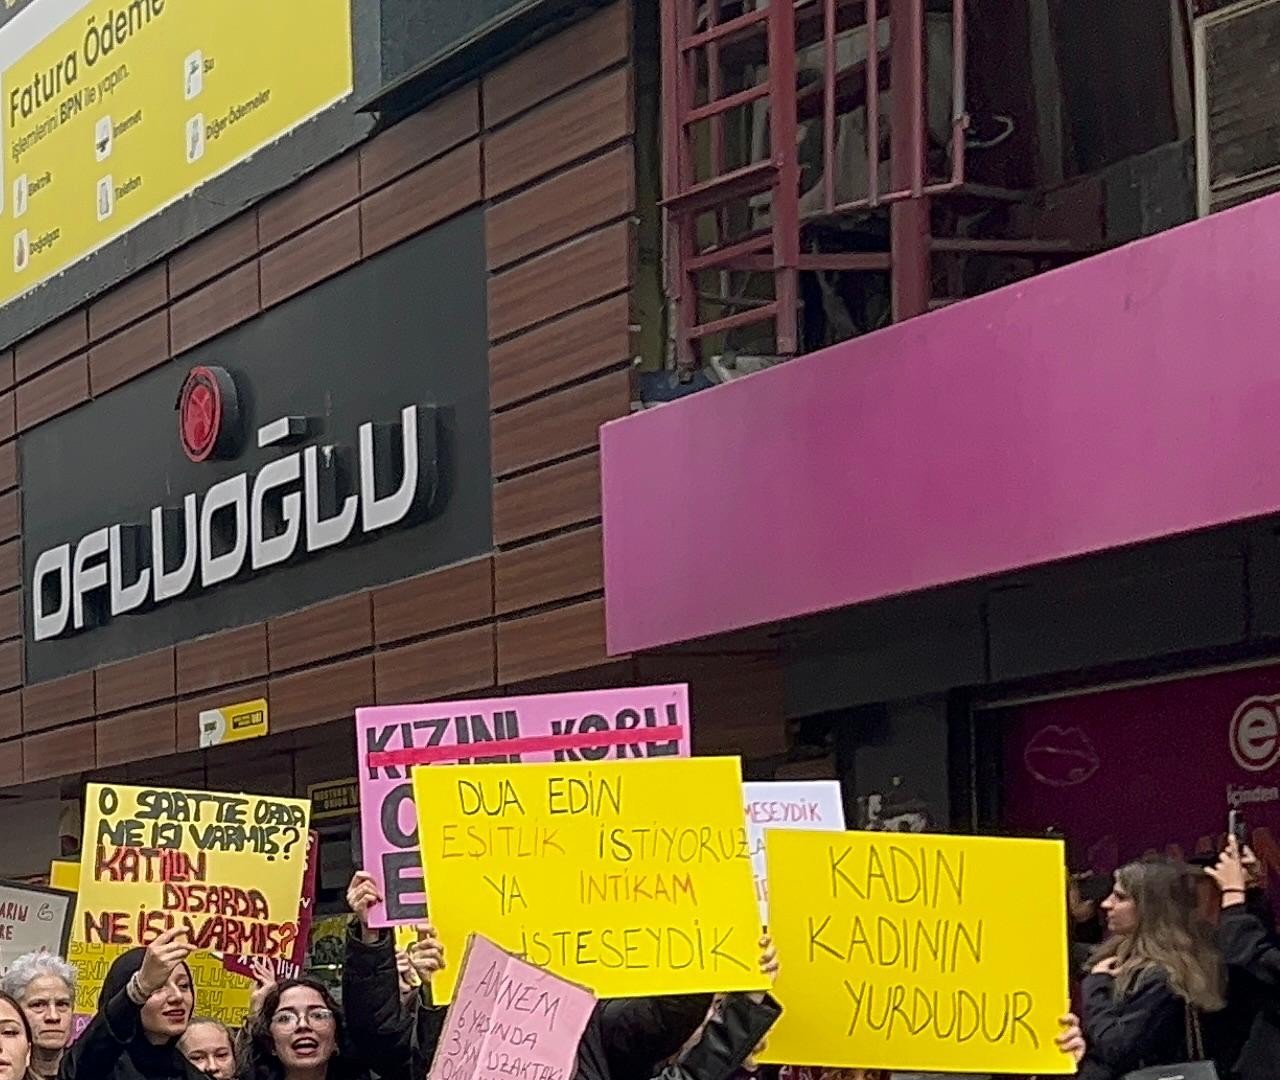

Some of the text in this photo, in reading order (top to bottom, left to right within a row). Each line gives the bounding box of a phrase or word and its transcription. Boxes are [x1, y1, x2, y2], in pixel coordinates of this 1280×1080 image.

[9, 51, 78, 129] Fatura
[59, 88, 83, 125] BPN
[32, 403, 420, 643] OFLUOĞLU
[366, 702, 681, 782] KIZINI KORU
[98, 786, 119, 815] O
[458, 771, 623, 818] DUA EDİN
[97, 819, 146, 847] NE
[598, 819, 751, 866] İSTİYORUZ
[483, 872, 528, 918] YA
[829, 844, 966, 908] KADIN
[83, 910, 133, 945] NE
[807, 912, 984, 975] KADININ
[474, 960, 561, 1032] ANNEM
[843, 979, 1042, 1050] YURDUDUR
[447, 1031, 463, 1057] 3
[456, 1002, 539, 1050] 6 YAŞINDA
